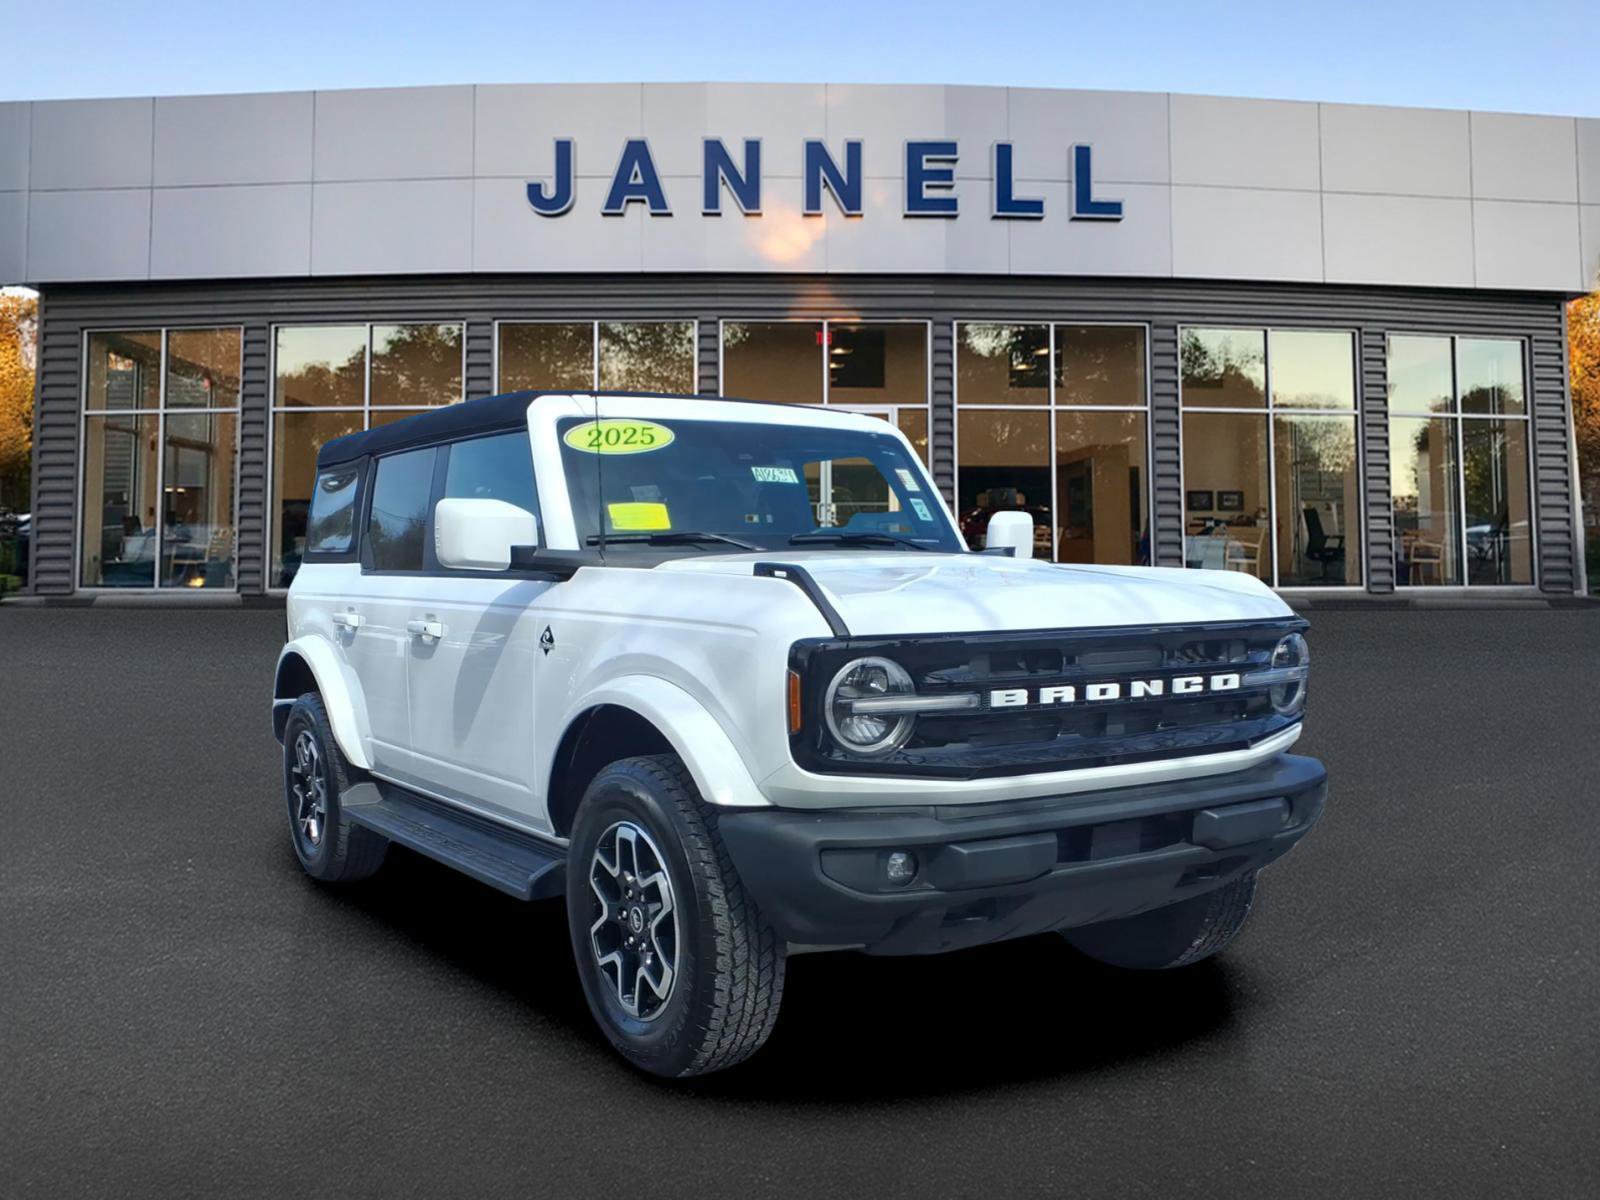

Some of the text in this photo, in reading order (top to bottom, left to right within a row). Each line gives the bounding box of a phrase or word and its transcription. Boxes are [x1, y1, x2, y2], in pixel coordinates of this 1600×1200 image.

[525, 136, 1125, 220] JANNELL
[587, 426, 656, 449] 2025
[990, 673, 1241, 708] BRONCO
